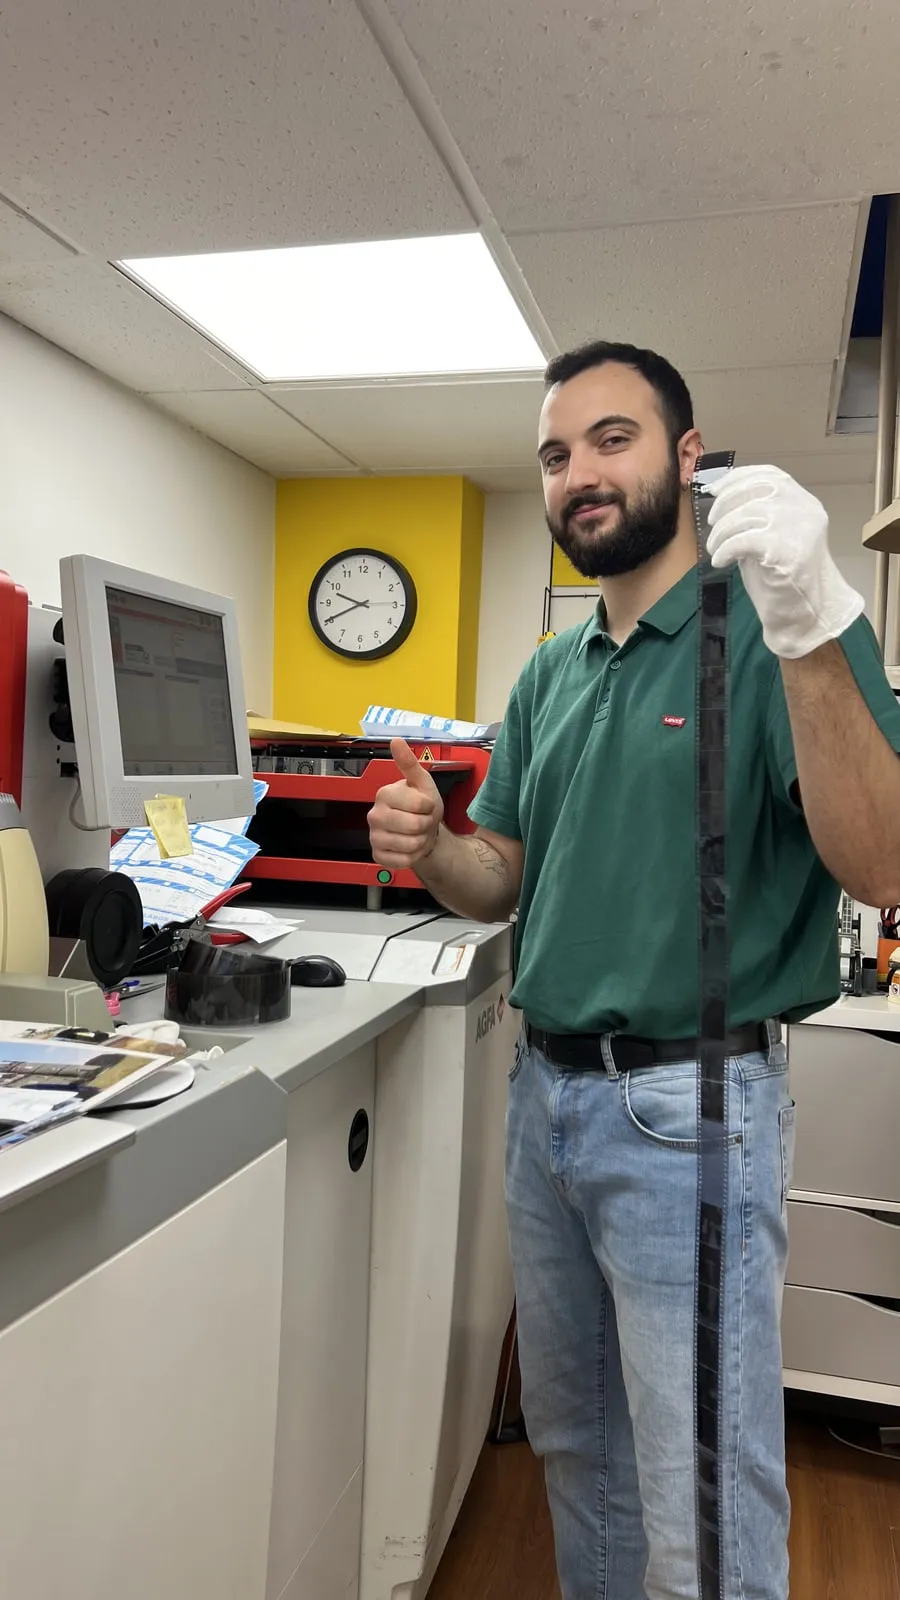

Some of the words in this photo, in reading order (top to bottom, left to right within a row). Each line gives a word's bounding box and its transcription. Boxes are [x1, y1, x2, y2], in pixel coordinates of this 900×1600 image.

[343, 570, 351, 578] 11
[358, 566, 369, 574] 12
[378, 571, 382, 579] 1
[331, 582, 341, 590] 10
[388, 584, 394, 592] 2
[326, 599, 331, 607] 9
[392, 601, 398, 609] 3
[340, 629, 346, 637] 7
[357, 635, 363, 643] 6
[475, 1003, 496, 1044] AGFA
